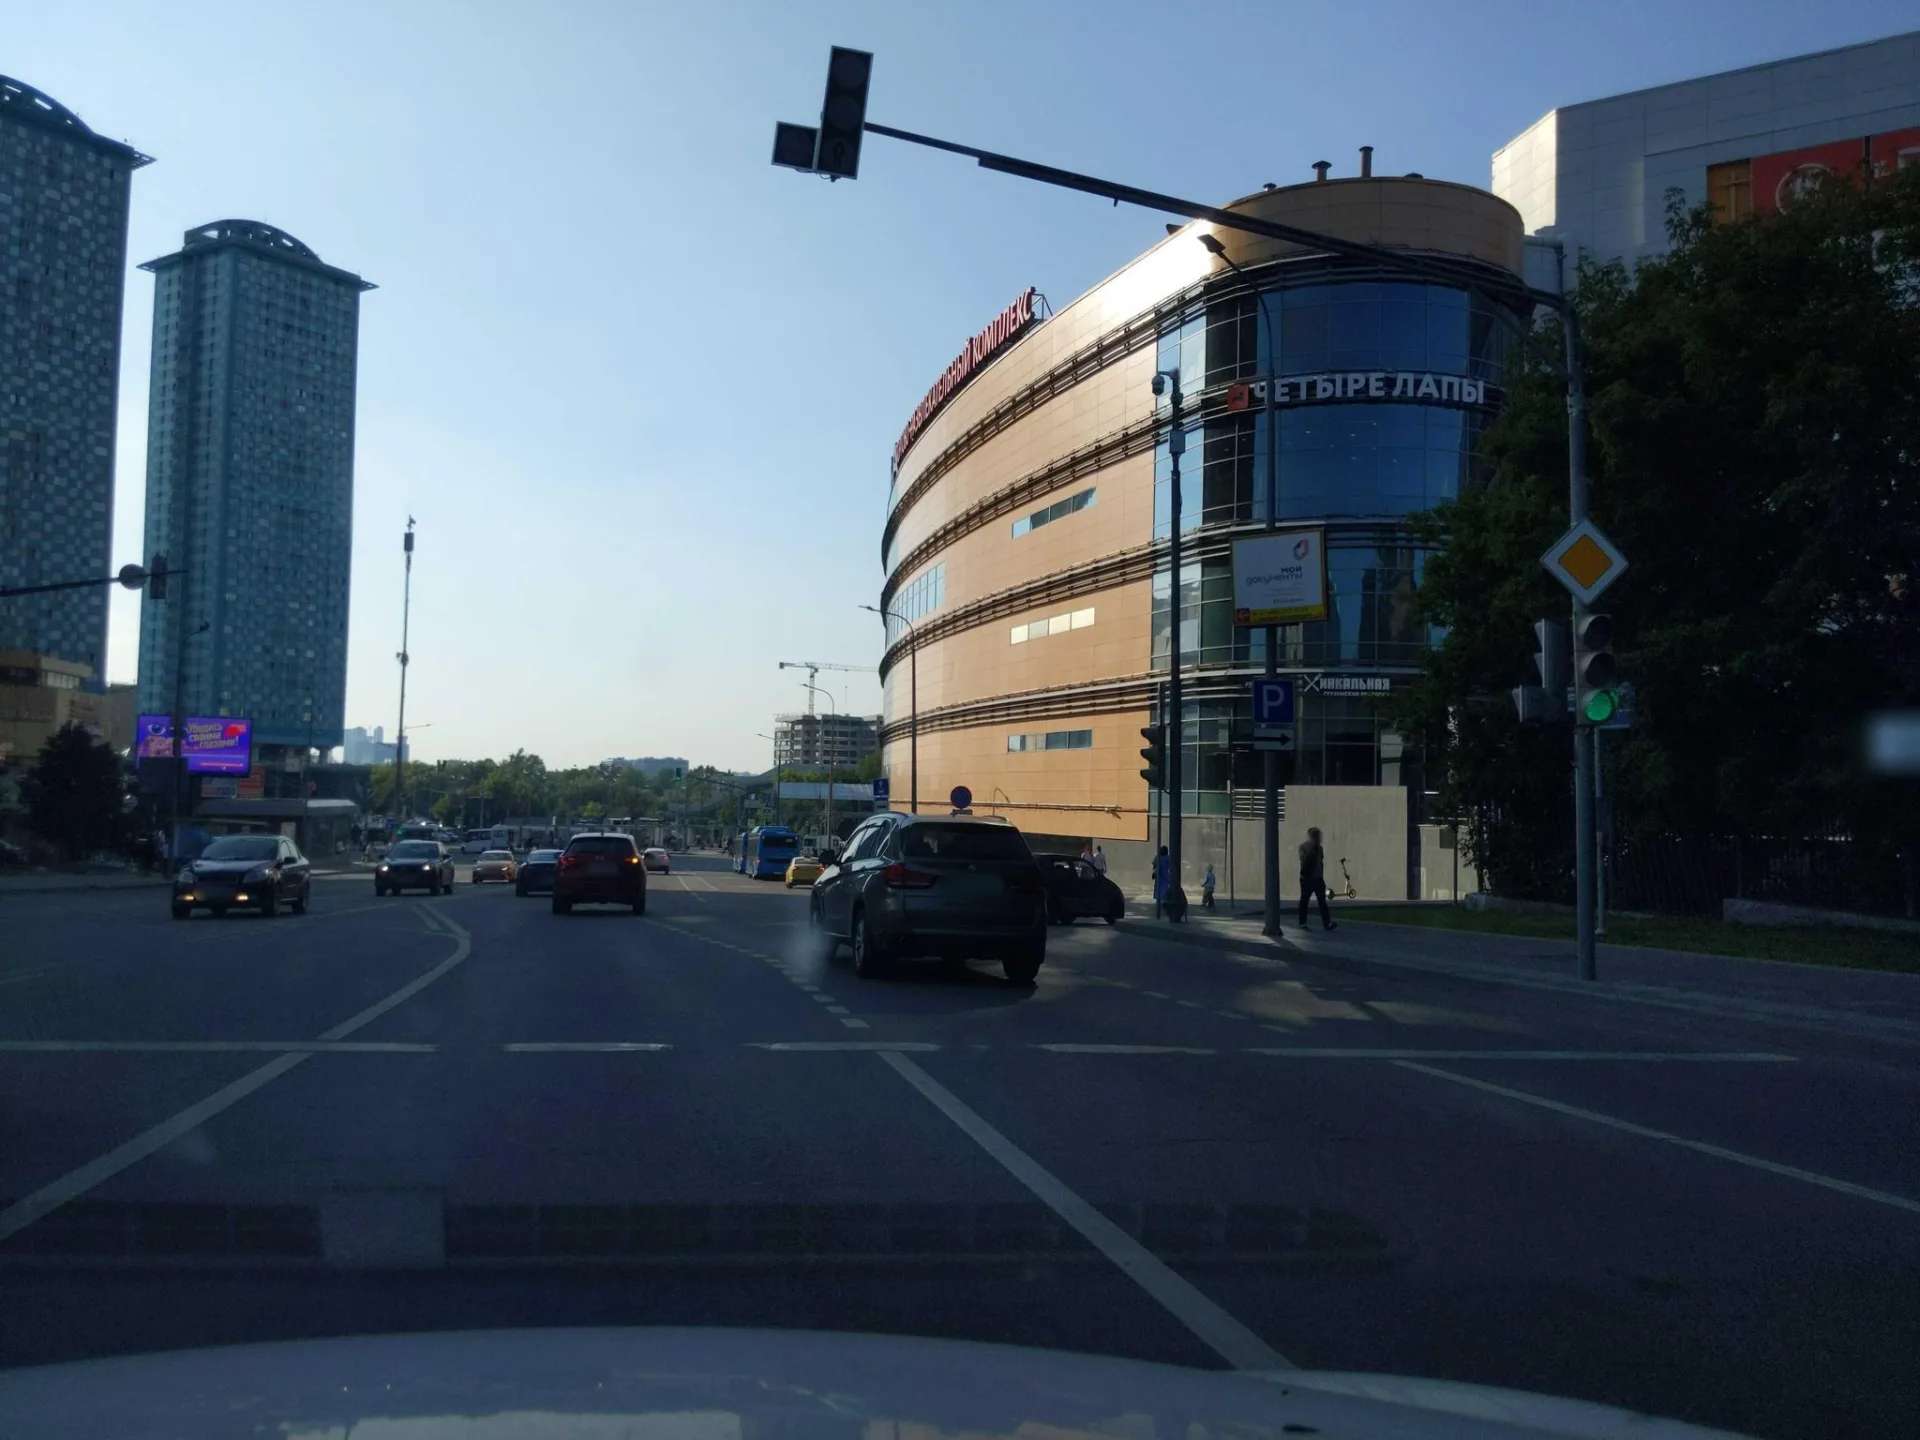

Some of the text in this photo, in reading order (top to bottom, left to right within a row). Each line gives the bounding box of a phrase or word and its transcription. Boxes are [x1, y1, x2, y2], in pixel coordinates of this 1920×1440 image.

[972, 287, 1031, 369] КОМПЛЕКС
[1253, 372, 1485, 405] ЧЕТЫРЕ ЛАПЫ
